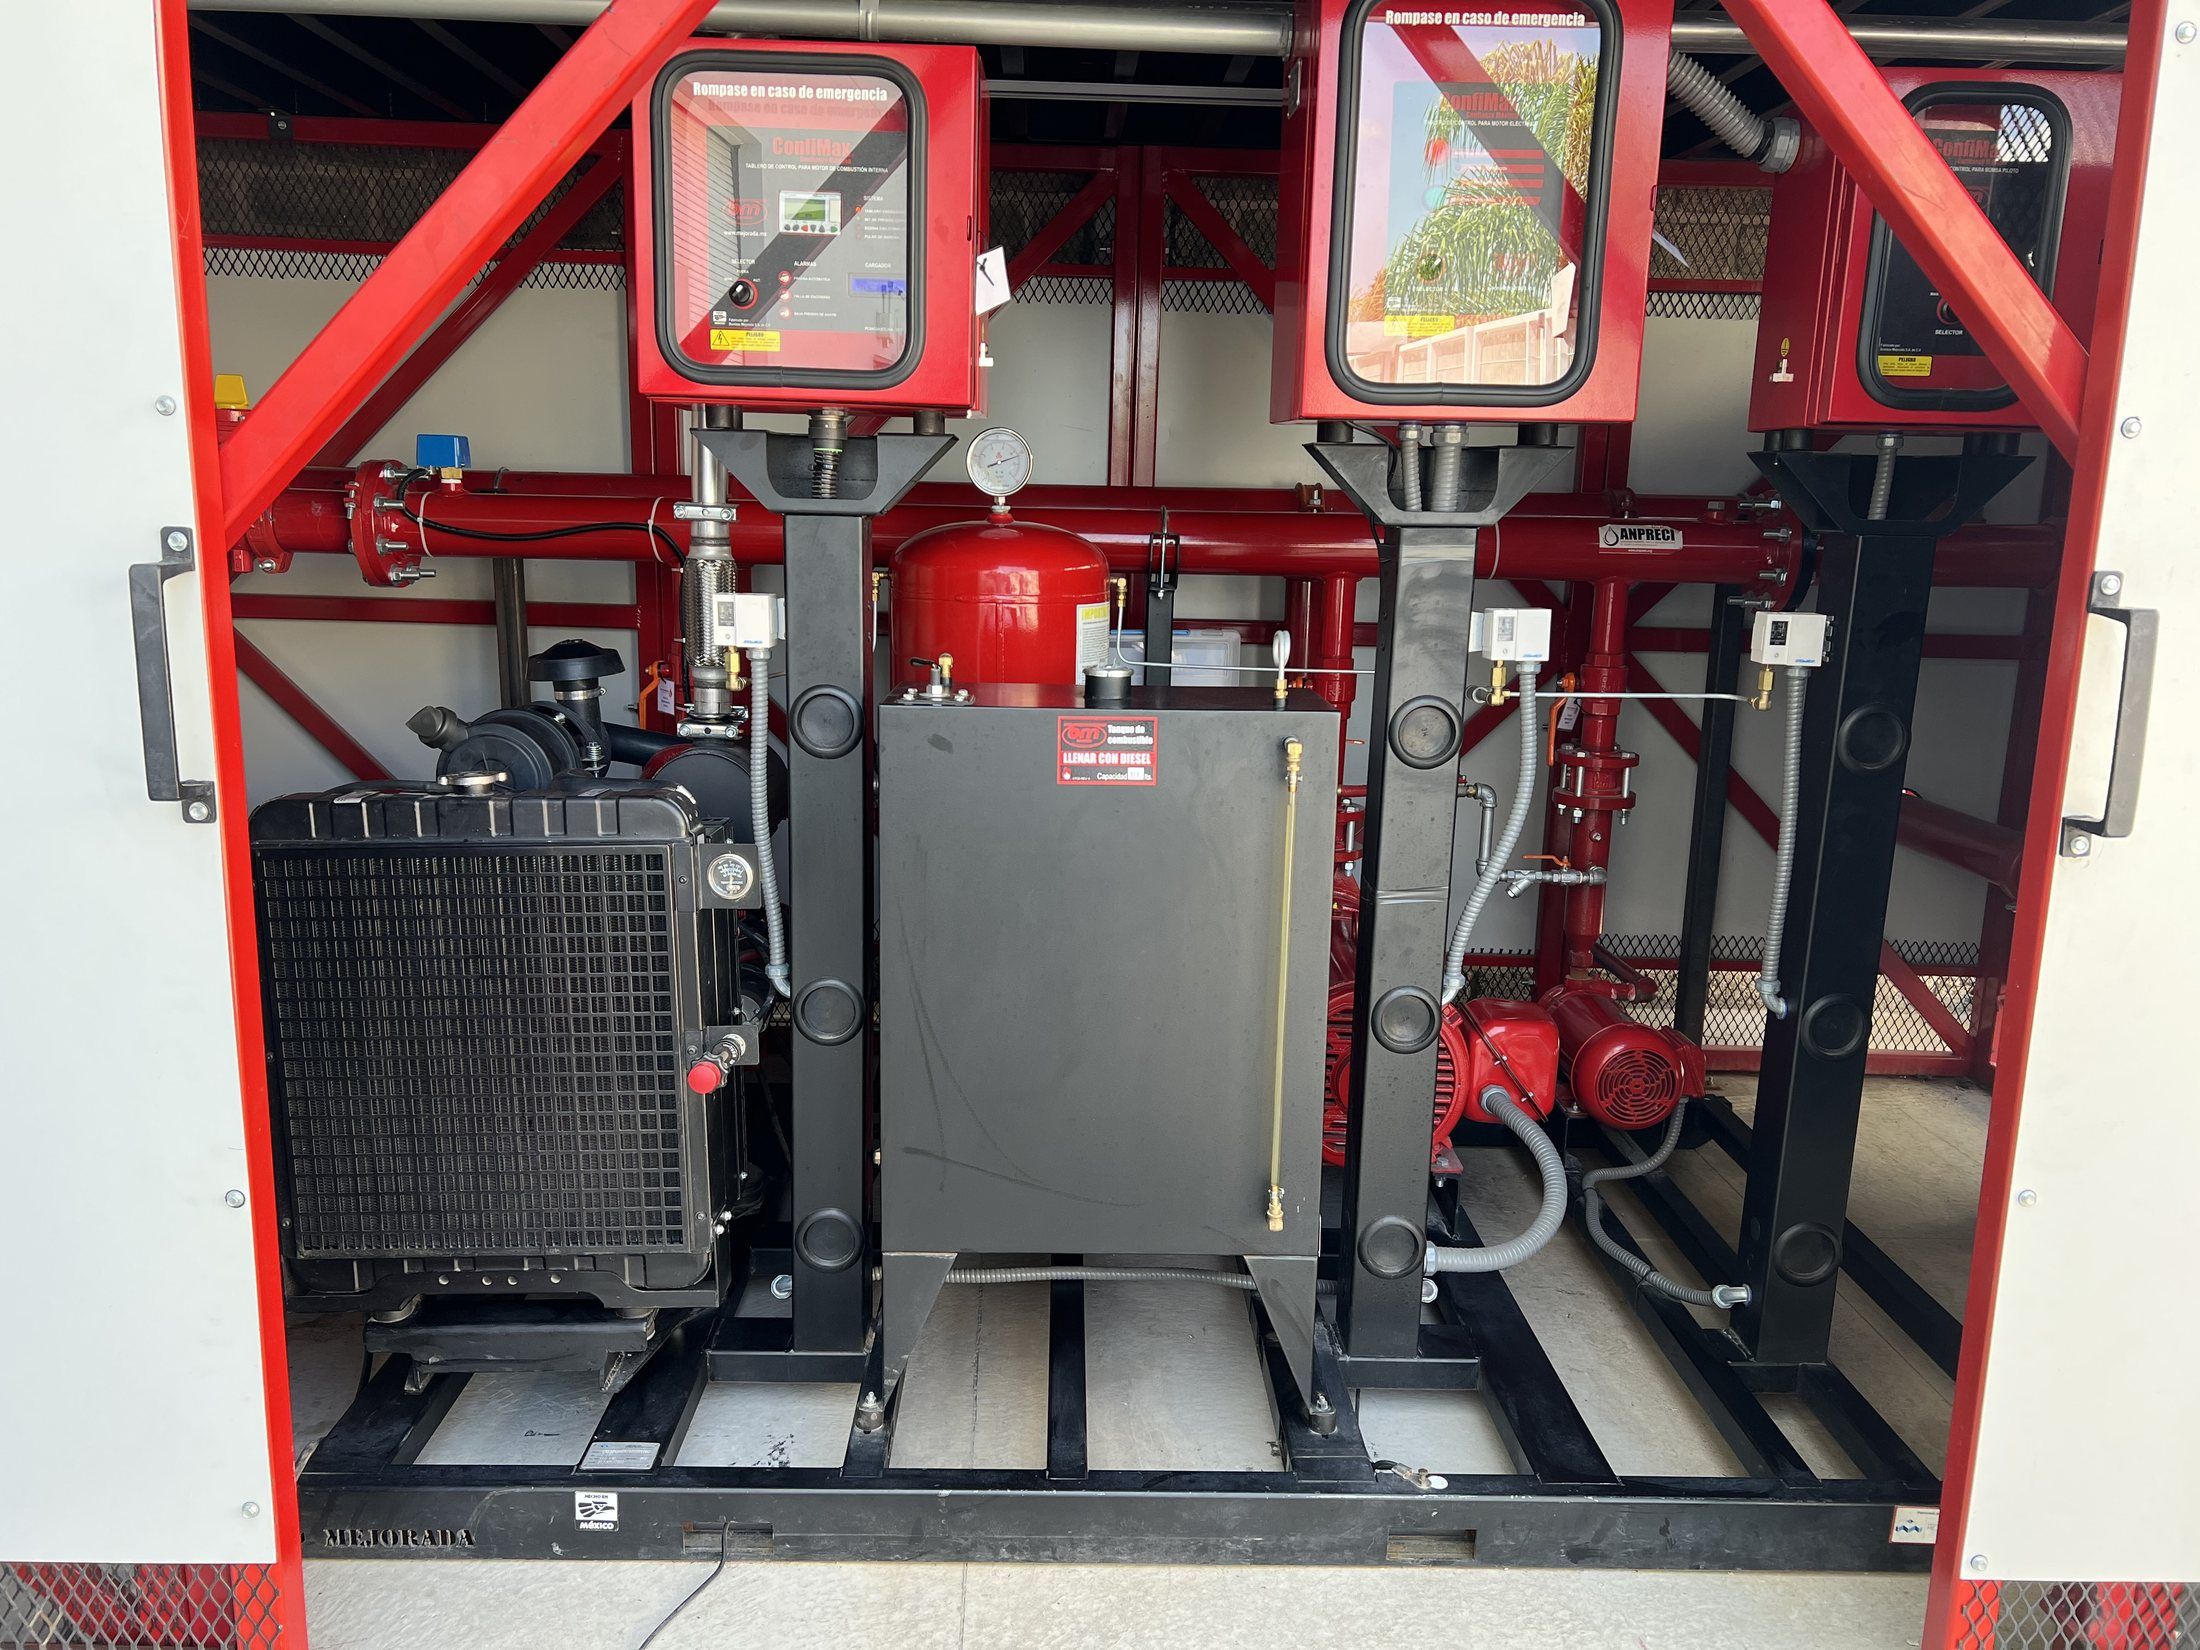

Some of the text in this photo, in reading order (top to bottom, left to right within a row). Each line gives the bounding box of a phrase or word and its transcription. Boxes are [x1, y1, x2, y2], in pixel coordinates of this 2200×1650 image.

[1386, 10, 1585, 27] Rompase en caso de emergencia
[693, 82, 888, 101] Rompase en caso de emergencia
[1620, 527, 1675, 541] ANPRECI
[1107, 725, 1134, 735] Tanque
[1135, 725, 1145, 734] de
[1107, 736, 1153, 745] combustible
[1063, 752, 1151, 764] LLENAR CON DIESEL
[1096, 772, 1127, 781] Capacidad
[324, 1528, 476, 1548] MEJORADA
